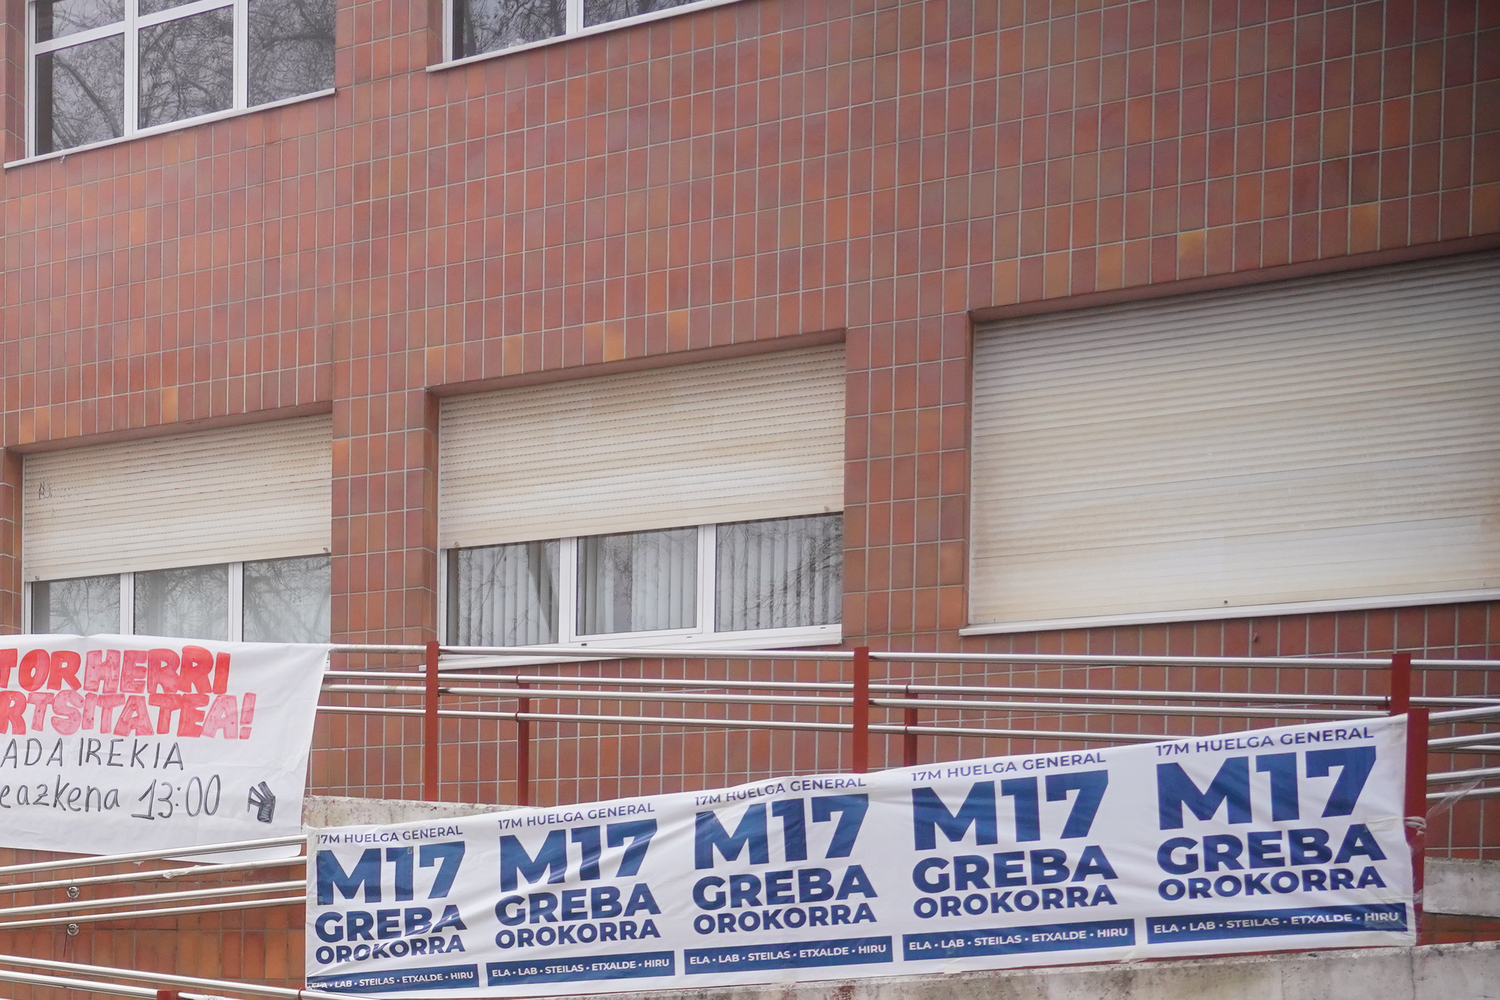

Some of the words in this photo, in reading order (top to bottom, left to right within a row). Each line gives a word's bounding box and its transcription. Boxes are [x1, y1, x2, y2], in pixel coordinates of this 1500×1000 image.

[83, 645, 231, 694] HERRI
[78, 737, 184, 770] IREKIA
[1156, 742, 1190, 756] 17M
[1196, 735, 1275, 753] HUELGA
[1280, 727, 1375, 745] GENERAL
[911, 769, 941, 782] 17M
[947, 761, 1017, 778] HUELGA
[1022, 752, 1107, 770] GENERAL
[131, 774, 221, 821] 13:00
[695, 794, 721, 806] 17M
[726, 783, 786, 802] HUELGA
[790, 778, 867, 792] GENERAL
[1156, 745, 1377, 831] M17
[498, 819, 522, 829] 17M
[526, 812, 584, 827] HUELGA
[587, 803, 656, 819] GENERAL
[911, 769, 1109, 851] M17
[316, 834, 340, 844] 17M
[344, 831, 399, 843] HUELGA
[402, 825, 464, 840] GENERAL
[694, 793, 870, 870] M17
[499, 818, 658, 893] M17
[1157, 823, 1388, 875] GREBA
[316, 841, 466, 906] M17
[912, 845, 1119, 894] GREBA
[1157, 866, 1388, 901] OROKORRA
[495, 882, 662, 926] GREBA
[692, 864, 879, 911] GREBA
[913, 884, 1118, 919] OROKORRA
[315, 904, 468, 943] GREBA
[495, 918, 661, 949] OROKORRA
[693, 902, 878, 935] OROKORRA
[1153, 923, 1179, 934] ELA
[1189, 921, 1216, 932] LAB
[1226, 917, 1280, 929] STEILAS
[1290, 913, 1353, 925] ETXALDE
[1364, 911, 1399, 922] HIRU
[315, 934, 466, 964] OROKORRA
[690, 956, 711, 965] ELA
[718, 954, 740, 963] LAB
[747, 950, 791, 961] STEILAS
[799, 946, 849, 958] ETXALDE
[858, 944, 887, 955] HIRU
[908, 941, 932, 951] ELA
[941, 939, 965, 949] LAB
[974, 935, 1022, 946] STEILAS
[1031, 930, 1087, 942] ETXALDE
[1097, 927, 1129, 938] HIRU
[334, 979, 352, 988] LAB
[359, 976, 395, 987] STEILAS
[402, 973, 443, 984] ETXALDE
[450, 971, 474, 980] HIRU
[492, 969, 511, 977] ELA
[518, 967, 538, 976] LAB
[545, 964, 584, 974] STEILAS
[591, 961, 636, 972] ETXALDE
[644, 958, 670, 968] HIRU
